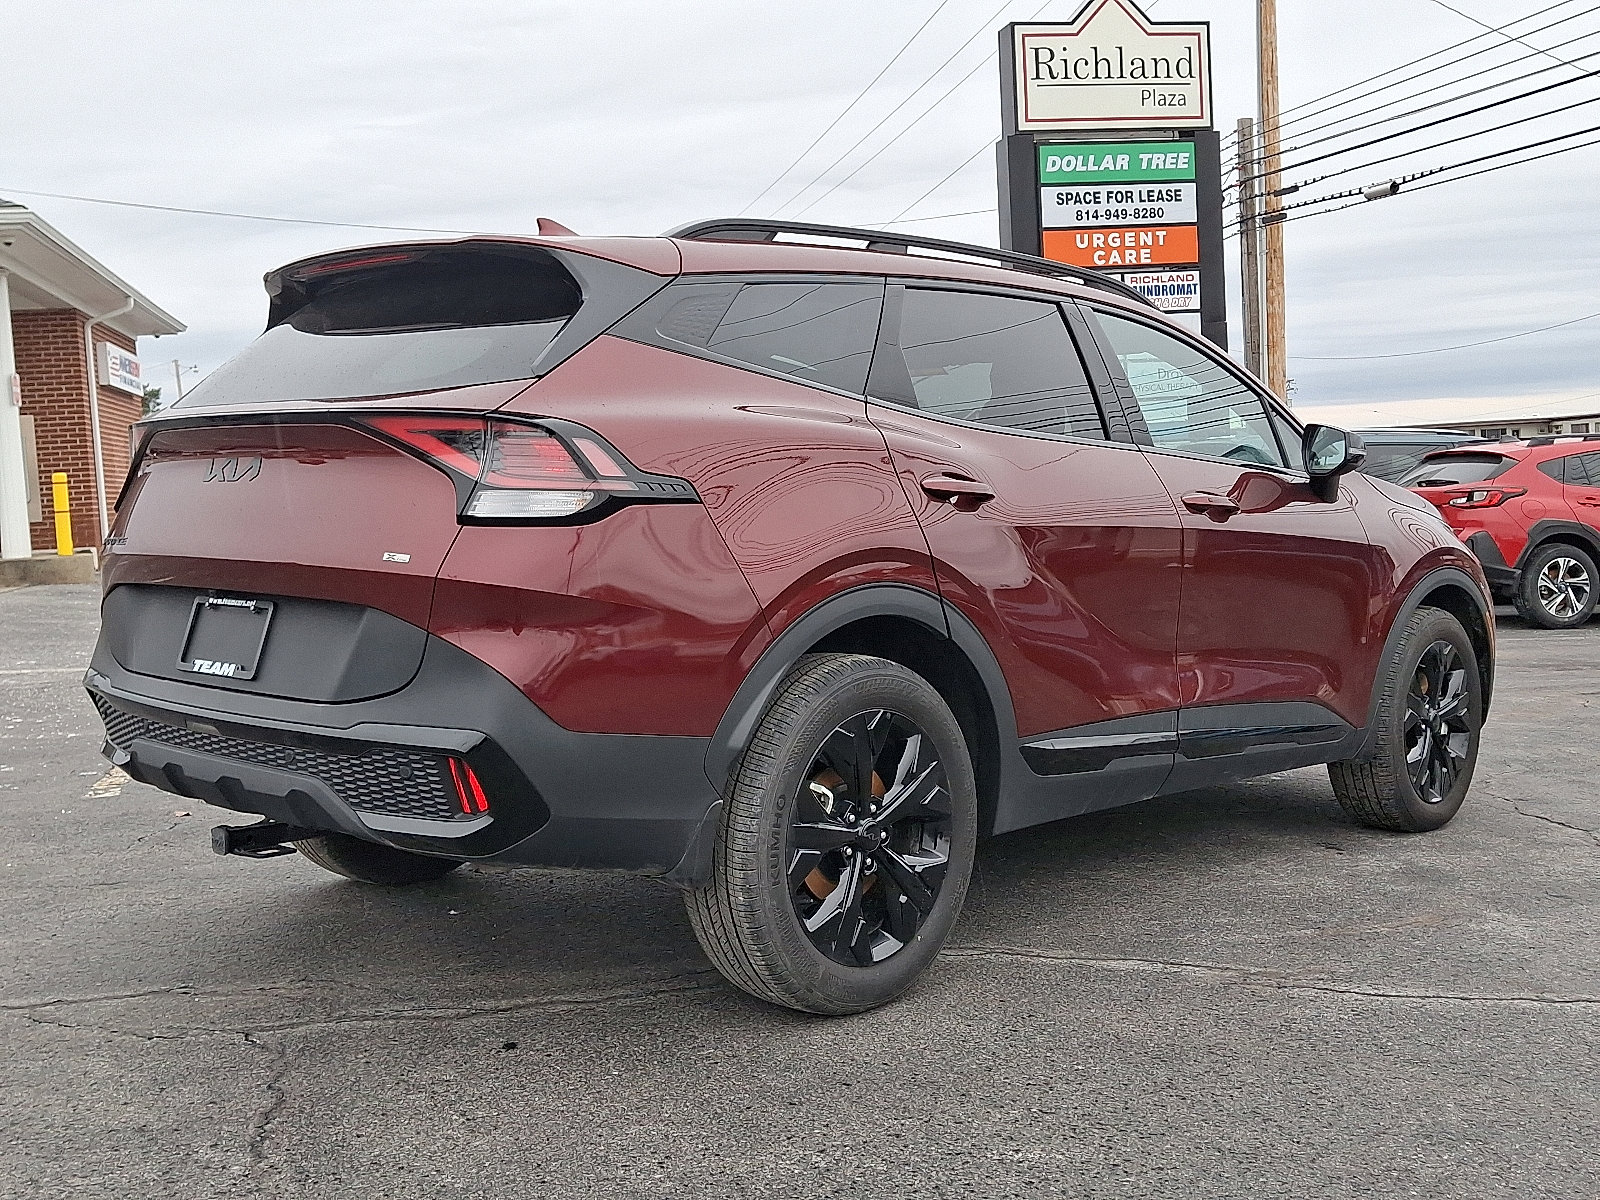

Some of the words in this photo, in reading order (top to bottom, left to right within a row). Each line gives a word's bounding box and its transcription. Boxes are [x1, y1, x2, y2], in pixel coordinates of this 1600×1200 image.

[1029, 46, 1196, 81] Richland
[1141, 88, 1187, 107] Plaza
[1045, 154, 1130, 173] DOLLAR
[1139, 152, 1190, 170] TREE
[1056, 191, 1101, 206] SPACE
[1106, 190, 1134, 204] FOR
[1139, 188, 1183, 203] LEASE
[1075, 207, 1164, 221] 814-949-8280
[1075, 230, 1167, 249] URGENT
[1093, 248, 1152, 265] CARE
[1130, 274, 1195, 284] RICHLAND
[1132, 283, 1198, 297] UNDROMAT
[1171, 297, 1192, 307] DRY
[1135, 384, 1165, 392] HYSICAL
[193, 659, 236, 677] TEAM
[769, 794, 786, 889] KUMHO
